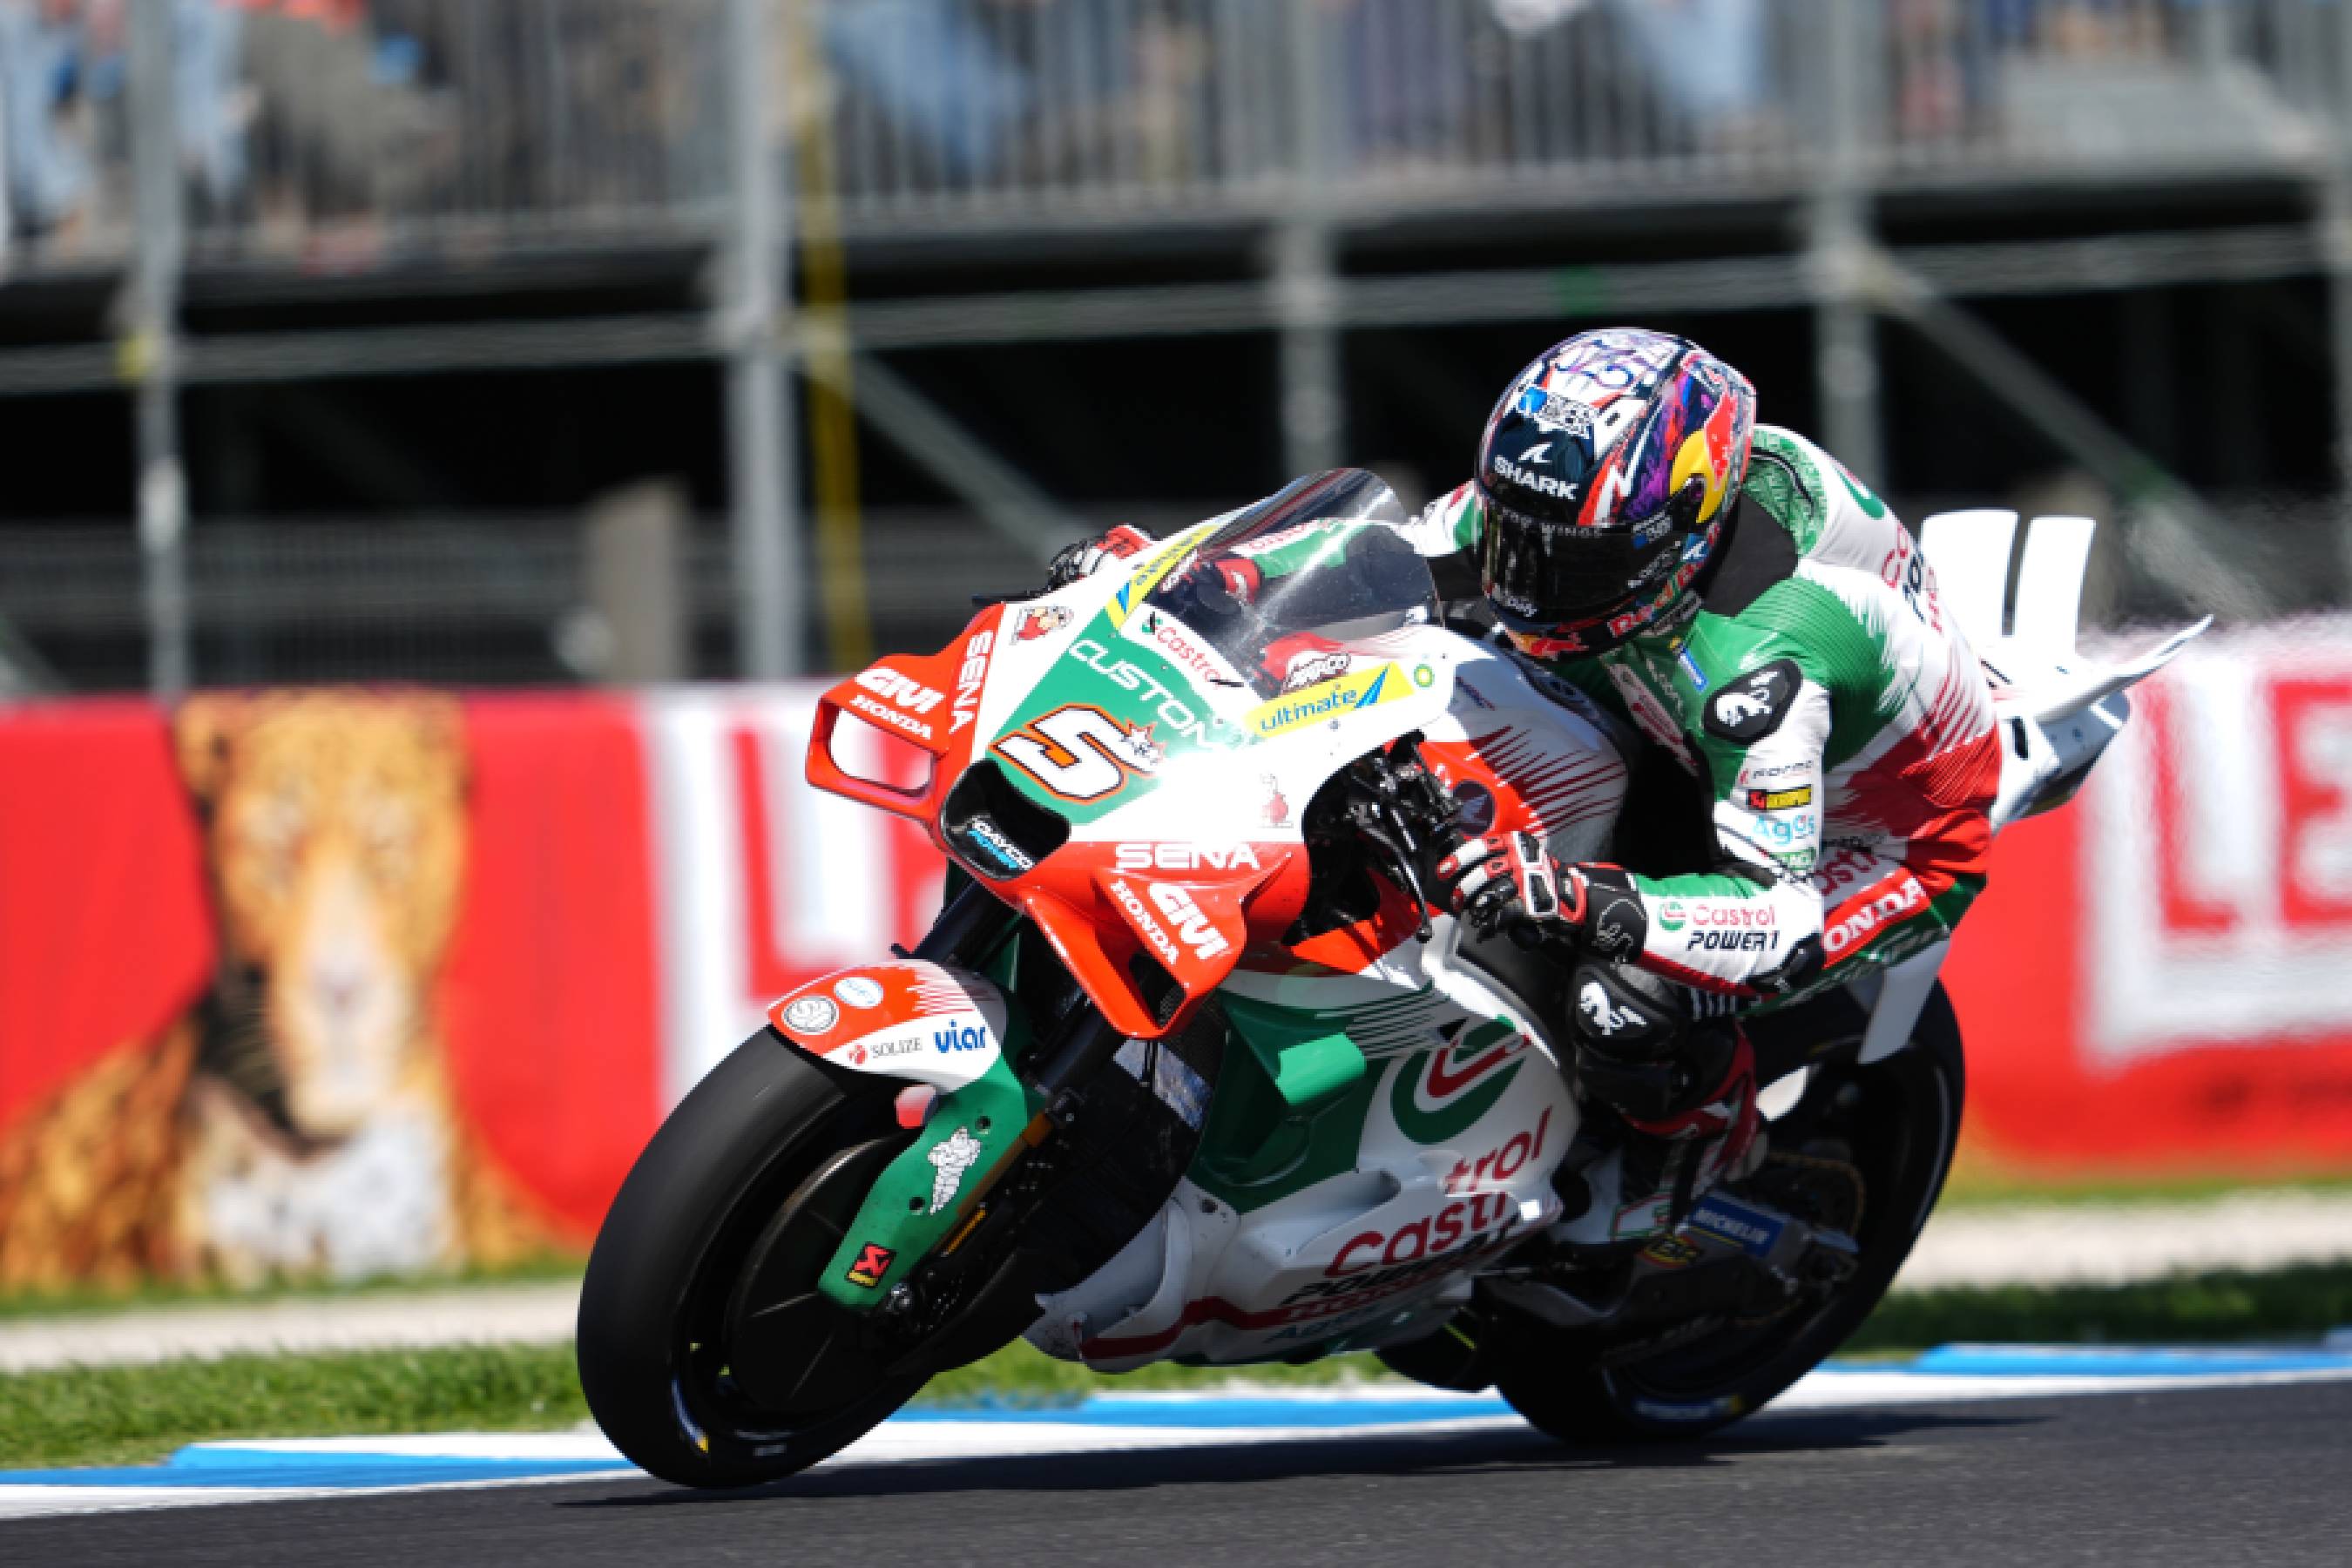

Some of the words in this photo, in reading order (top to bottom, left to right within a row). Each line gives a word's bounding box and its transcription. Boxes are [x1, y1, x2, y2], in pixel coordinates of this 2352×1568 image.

[1494, 455, 1579, 501] SHARK
[1154, 625, 1227, 690] Castro
[855, 666, 945, 714] GIVI
[949, 630, 994, 734] SENA
[849, 694, 931, 740] HONDA
[1260, 687, 1357, 731] ultimate
[988, 702, 1162, 805] 5
[1115, 842, 1261, 870] SENA
[1110, 879, 1179, 965] HONDA
[1149, 882, 1229, 960] GIVI
[1692, 902, 1776, 928] Castrol
[1822, 876, 1928, 952] ONDA
[1686, 929, 1781, 951] POWER1
[933, 1018, 986, 1054] viar
